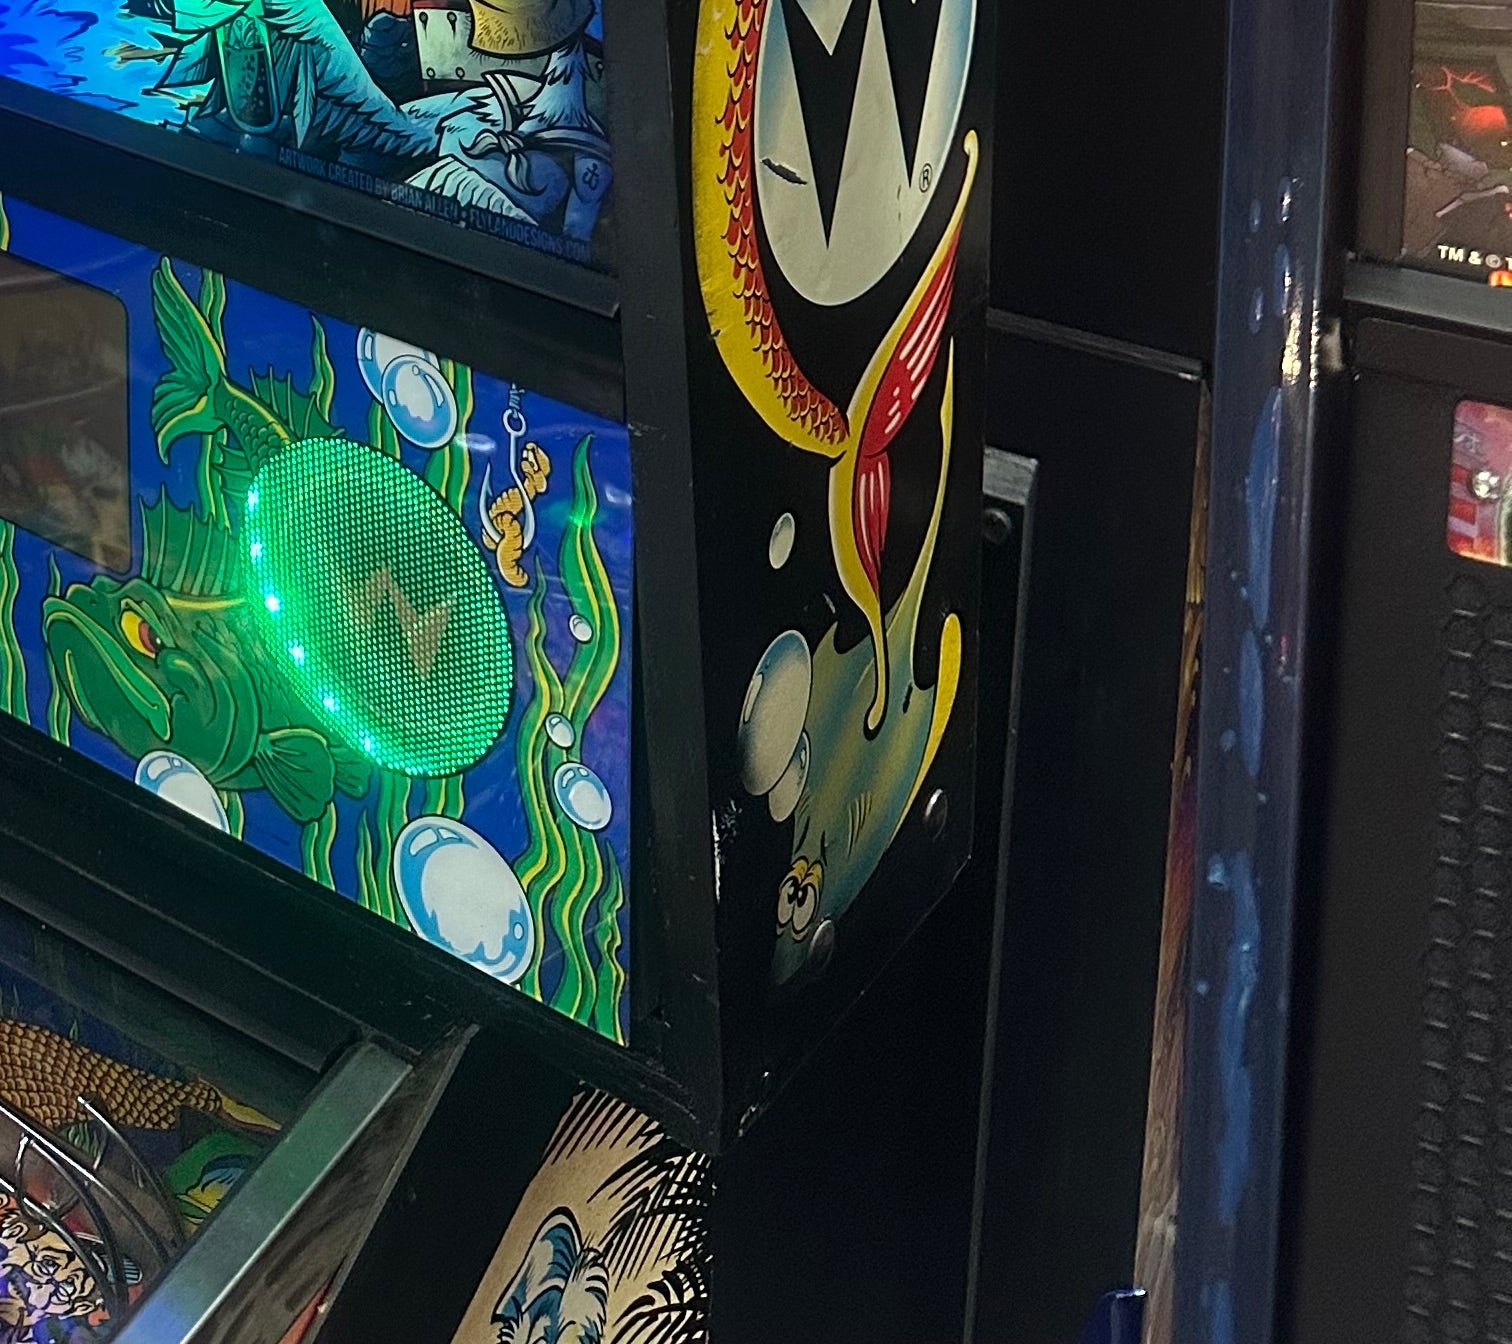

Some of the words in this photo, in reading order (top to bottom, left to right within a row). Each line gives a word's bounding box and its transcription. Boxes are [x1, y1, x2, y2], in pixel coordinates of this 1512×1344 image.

[278, 147, 327, 177] ARTWORK
[328, 162, 374, 192] CREATED
[391, 181, 424, 207] BRIAN
[1437, 244, 1465, 262] TM
[1468, 250, 1483, 265] &
